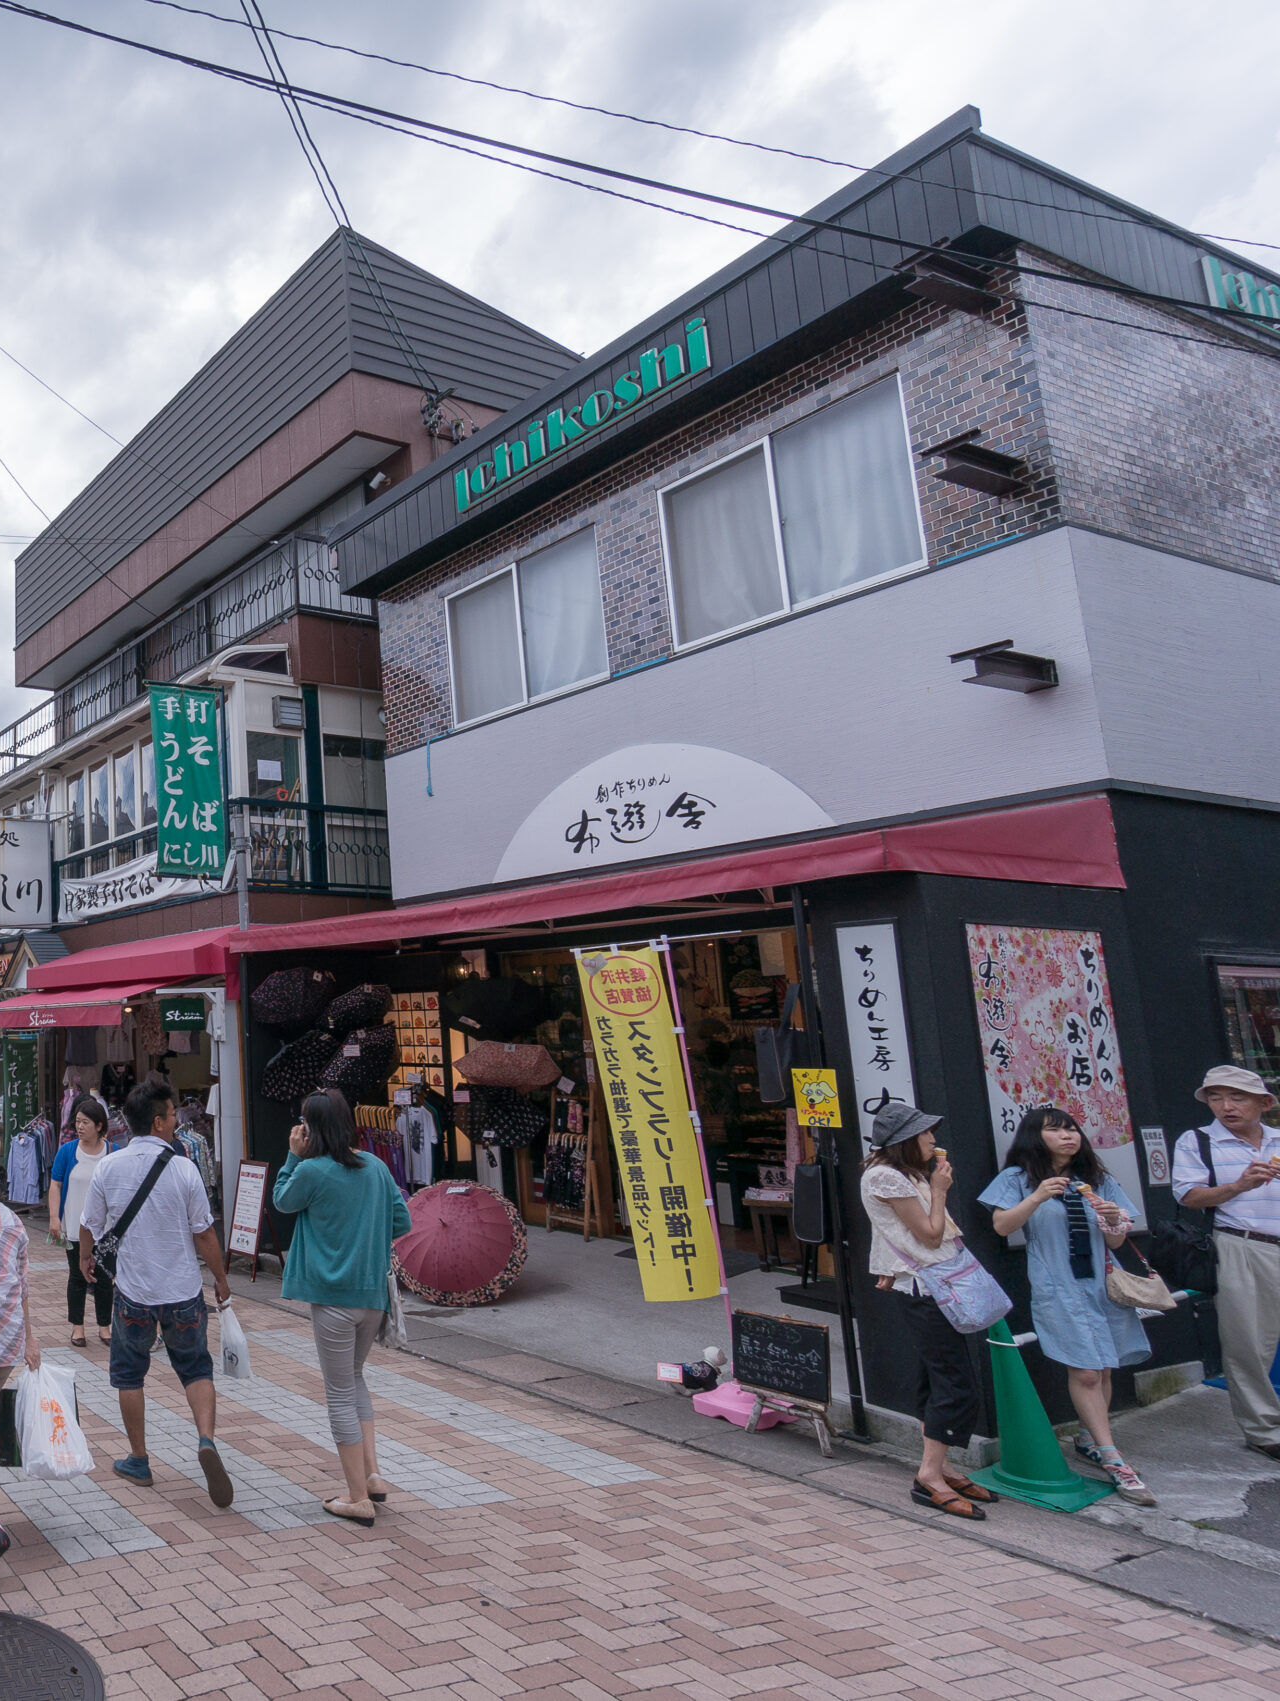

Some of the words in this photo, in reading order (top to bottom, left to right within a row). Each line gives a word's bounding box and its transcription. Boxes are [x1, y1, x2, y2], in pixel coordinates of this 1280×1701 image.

[455, 316, 711, 513] Ichikoshi
[595, 773, 671, 803] 創作ちりめん
[163, 842, 219, 868] にし川
[165, 1010, 204, 1021] Stream
[854, 944, 896, 1072] ちりめん工房
[1079, 946, 1114, 1085] ちりめんの
[1067, 1018, 1092, 1087] お店
